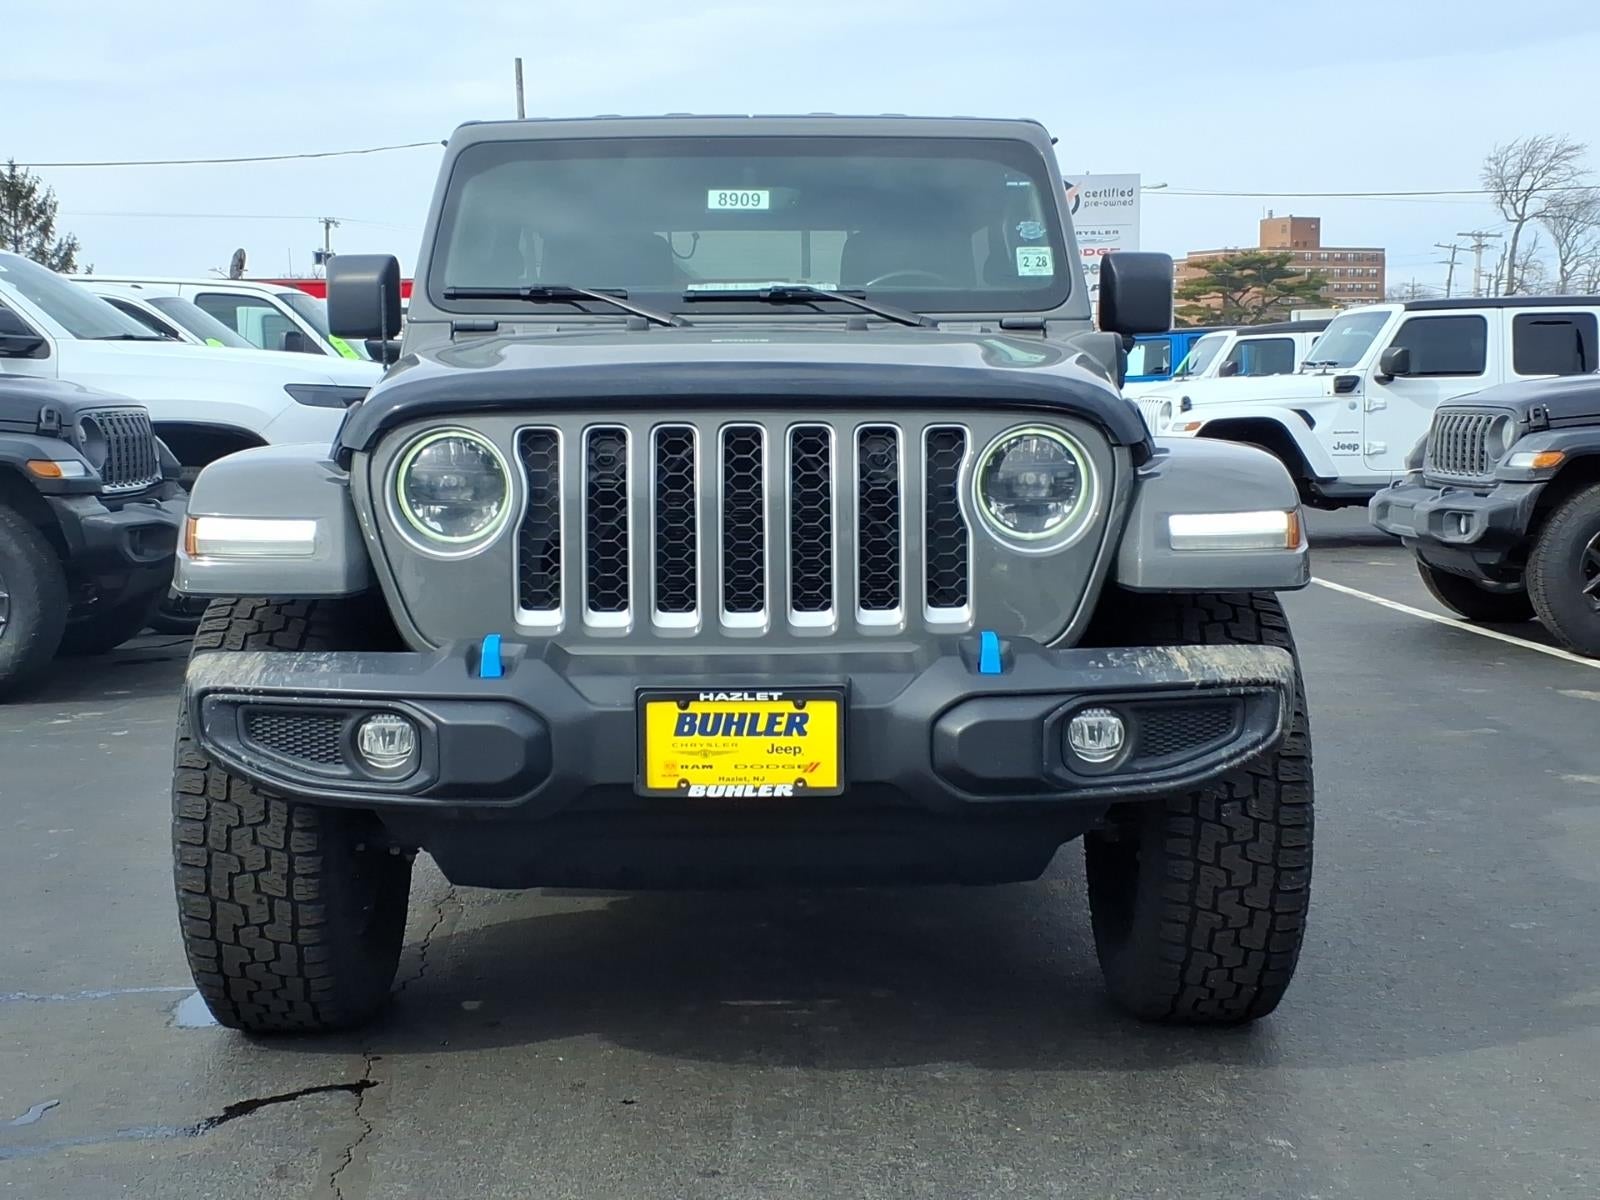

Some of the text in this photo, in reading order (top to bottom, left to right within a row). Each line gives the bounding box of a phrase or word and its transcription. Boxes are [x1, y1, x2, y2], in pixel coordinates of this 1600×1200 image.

[1084, 187, 1134, 198] certified
[718, 192, 761, 207] 8909
[1084, 198, 1134, 208] pre-owned
[1023, 256, 1048, 268] 2 28
[1332, 441, 1360, 452] Jeep
[699, 692, 783, 701] HAZLET
[673, 712, 810, 737] BUHLER
[766, 743, 802, 757] Jeep
[687, 784, 794, 798] BUHLER
